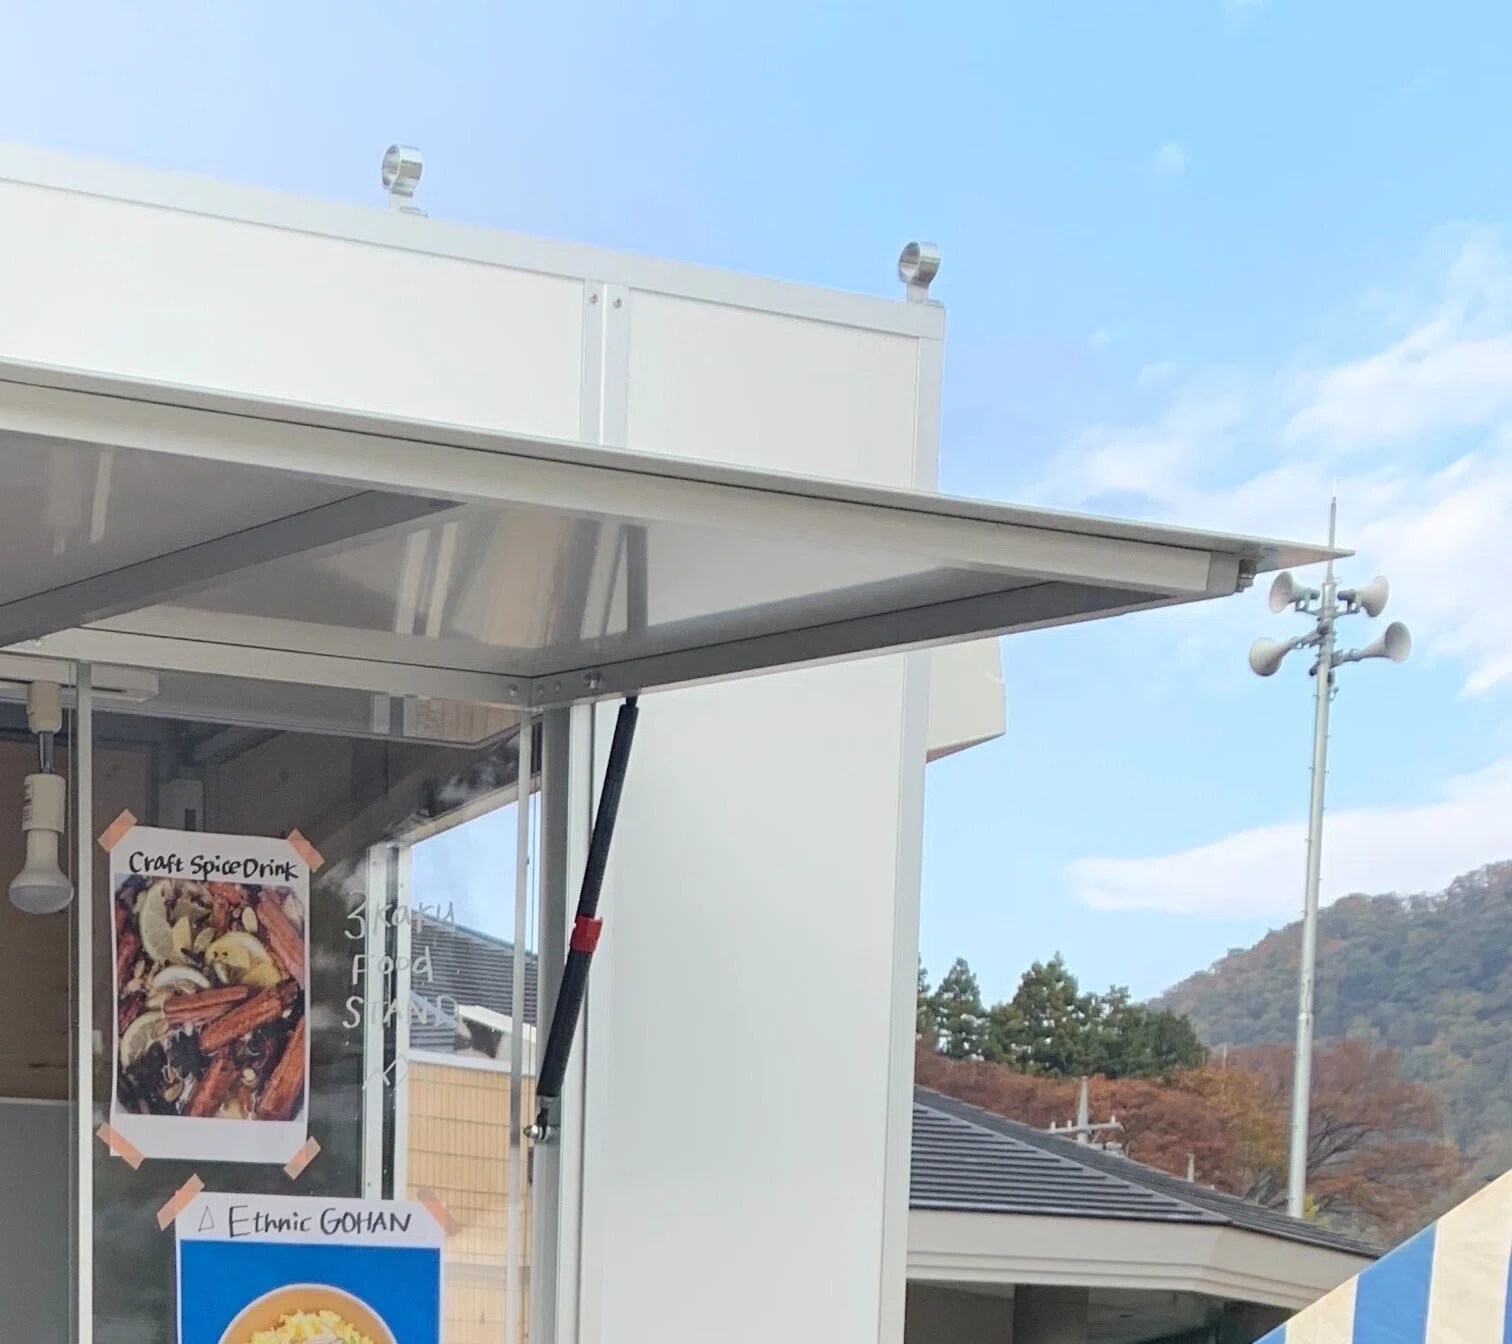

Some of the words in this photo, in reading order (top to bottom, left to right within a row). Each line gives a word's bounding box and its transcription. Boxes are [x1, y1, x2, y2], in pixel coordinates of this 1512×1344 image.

[128, 851, 185, 874] Craft
[190, 854, 241, 881] Spice
[242, 857, 299, 881] Drink
[352, 946, 434, 984] Food
[342, 995, 462, 1029] STAND
[228, 1205, 312, 1238] Ethnic
[319, 1207, 412, 1236] GOHAN
